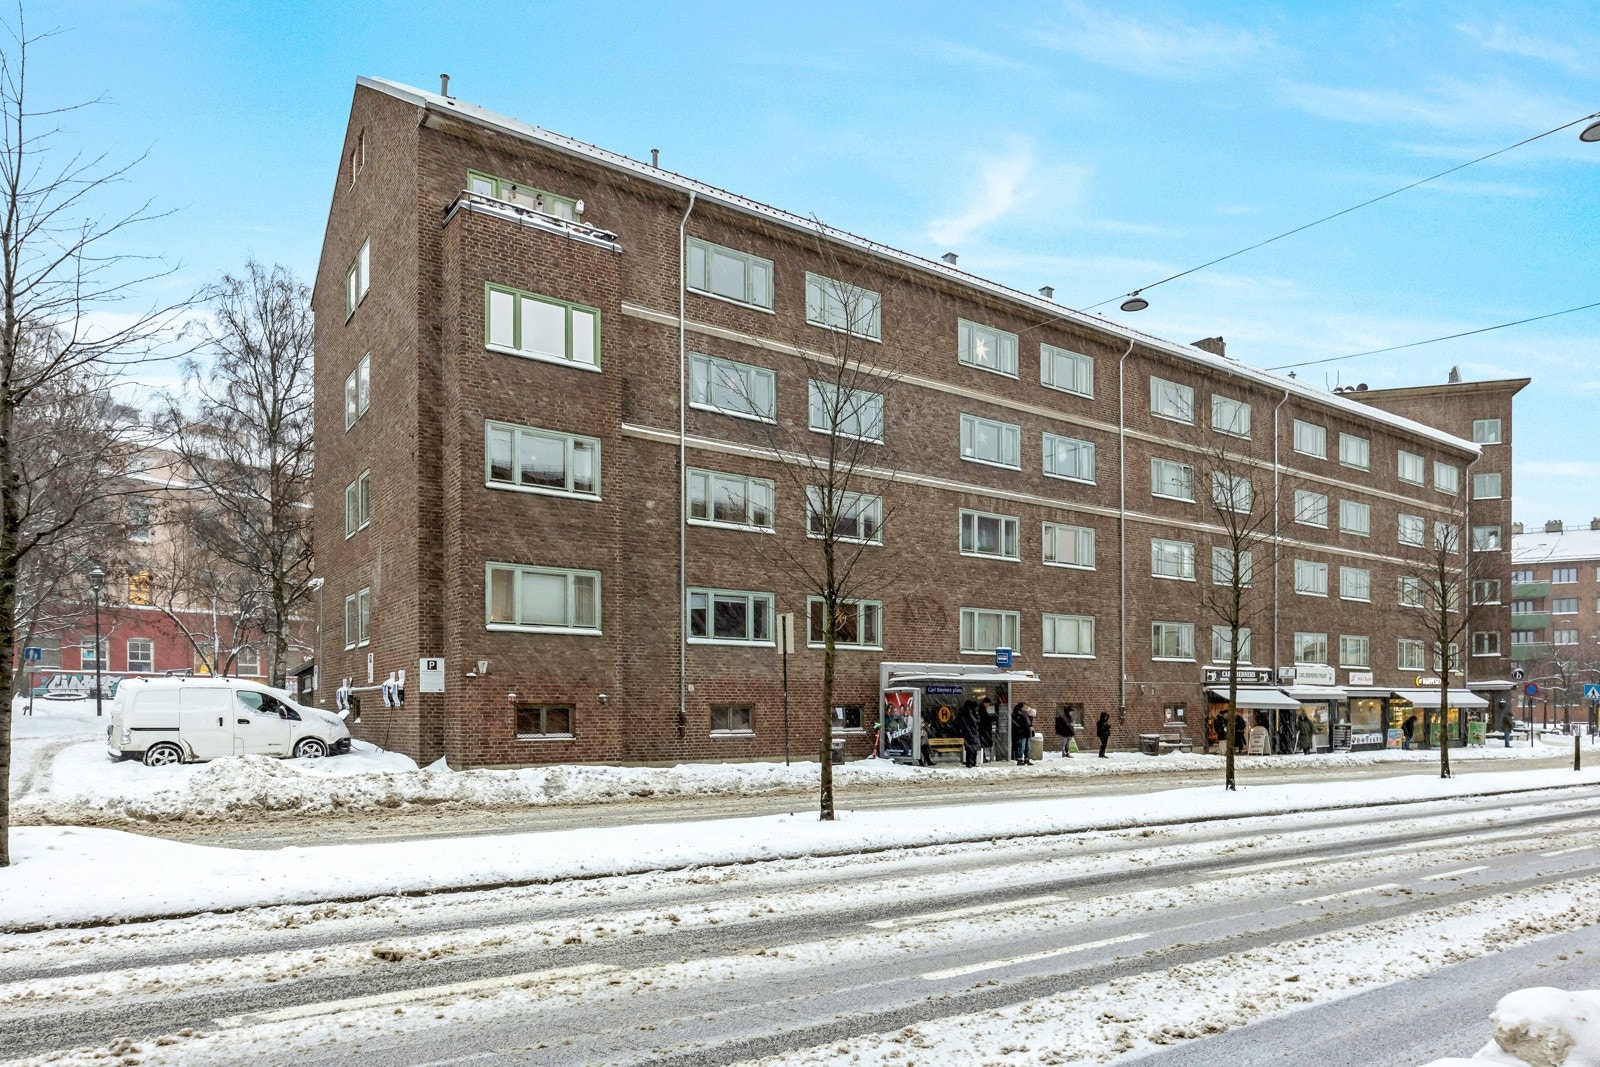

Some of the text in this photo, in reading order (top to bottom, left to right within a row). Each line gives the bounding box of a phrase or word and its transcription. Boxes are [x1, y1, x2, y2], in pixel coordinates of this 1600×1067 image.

[429, 661, 435, 669] P
[941, 709, 948, 720] H
[886, 725, 912, 744] Voice
